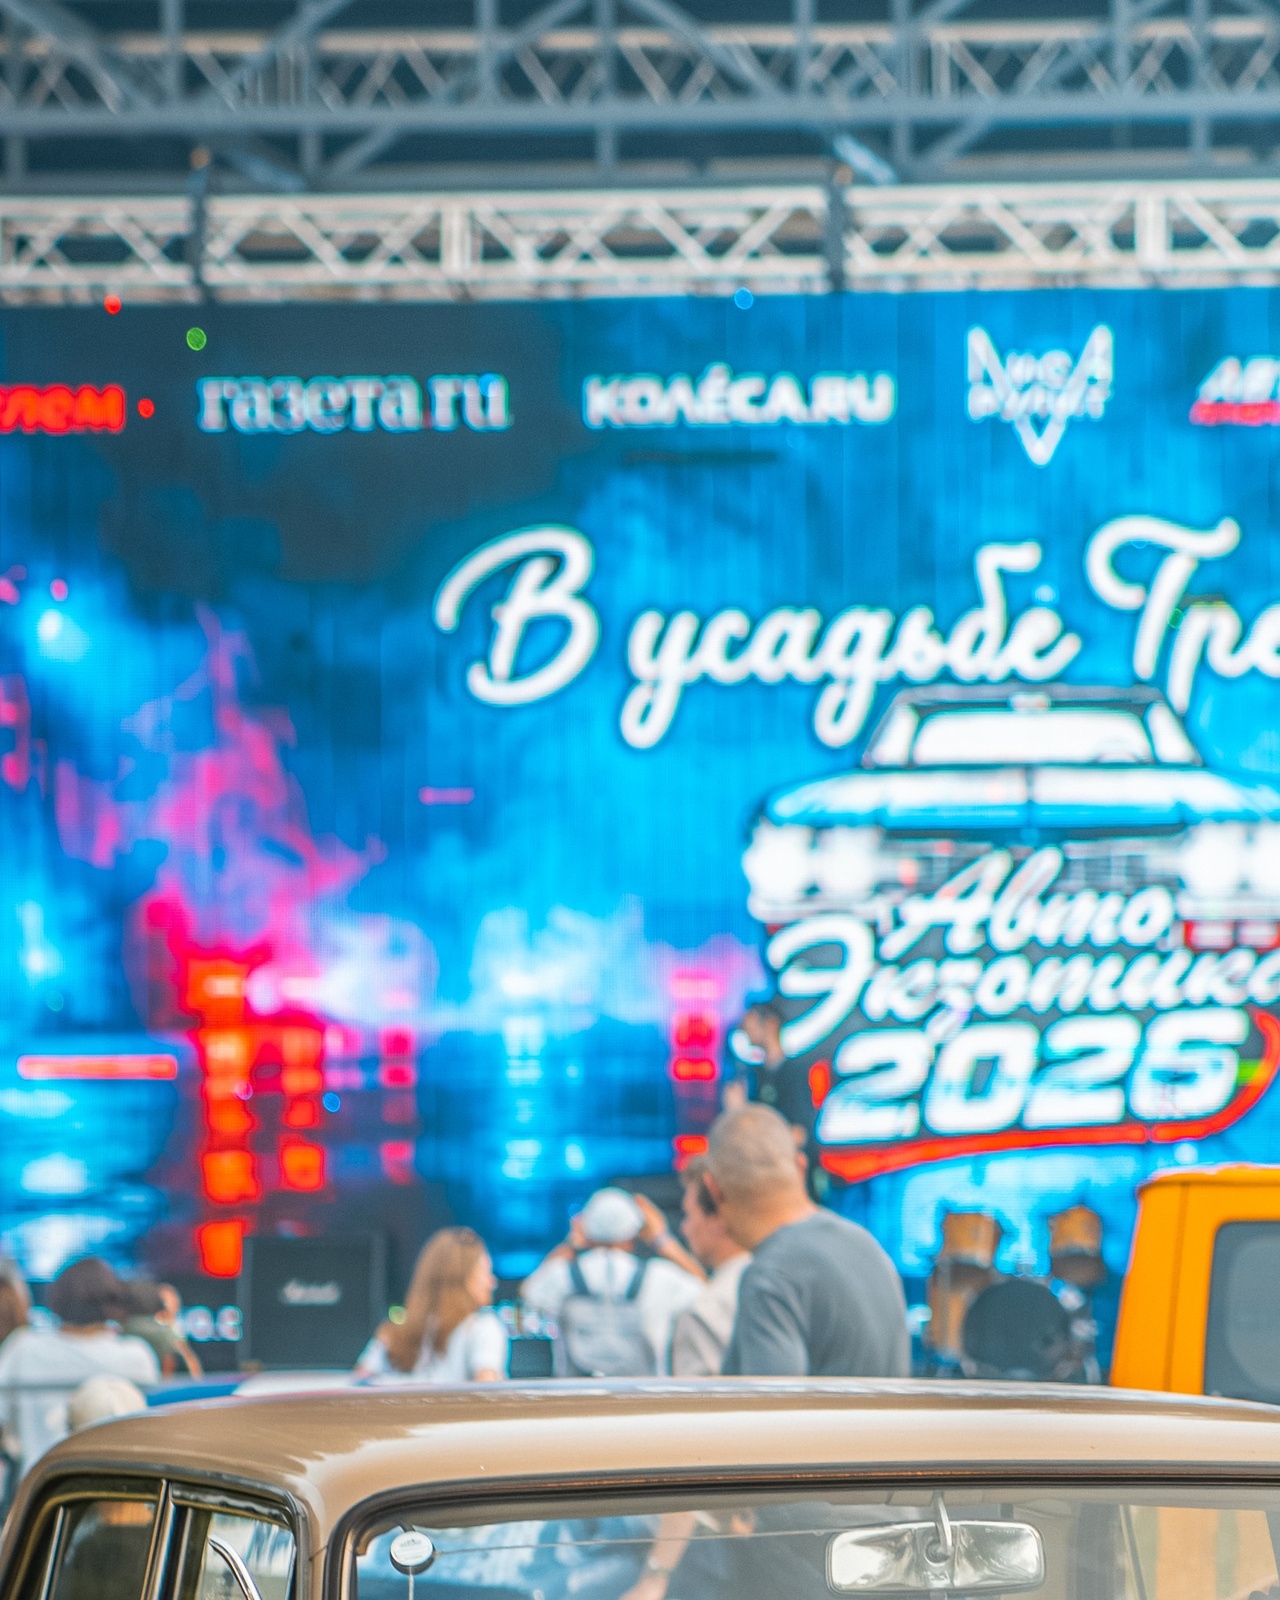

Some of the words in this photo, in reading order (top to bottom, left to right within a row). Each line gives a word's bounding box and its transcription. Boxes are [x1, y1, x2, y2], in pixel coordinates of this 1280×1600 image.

[434, 526, 598, 706] В
[619, 540, 1083, 748] усадьбе
[879, 845, 1177, 960] Авто
